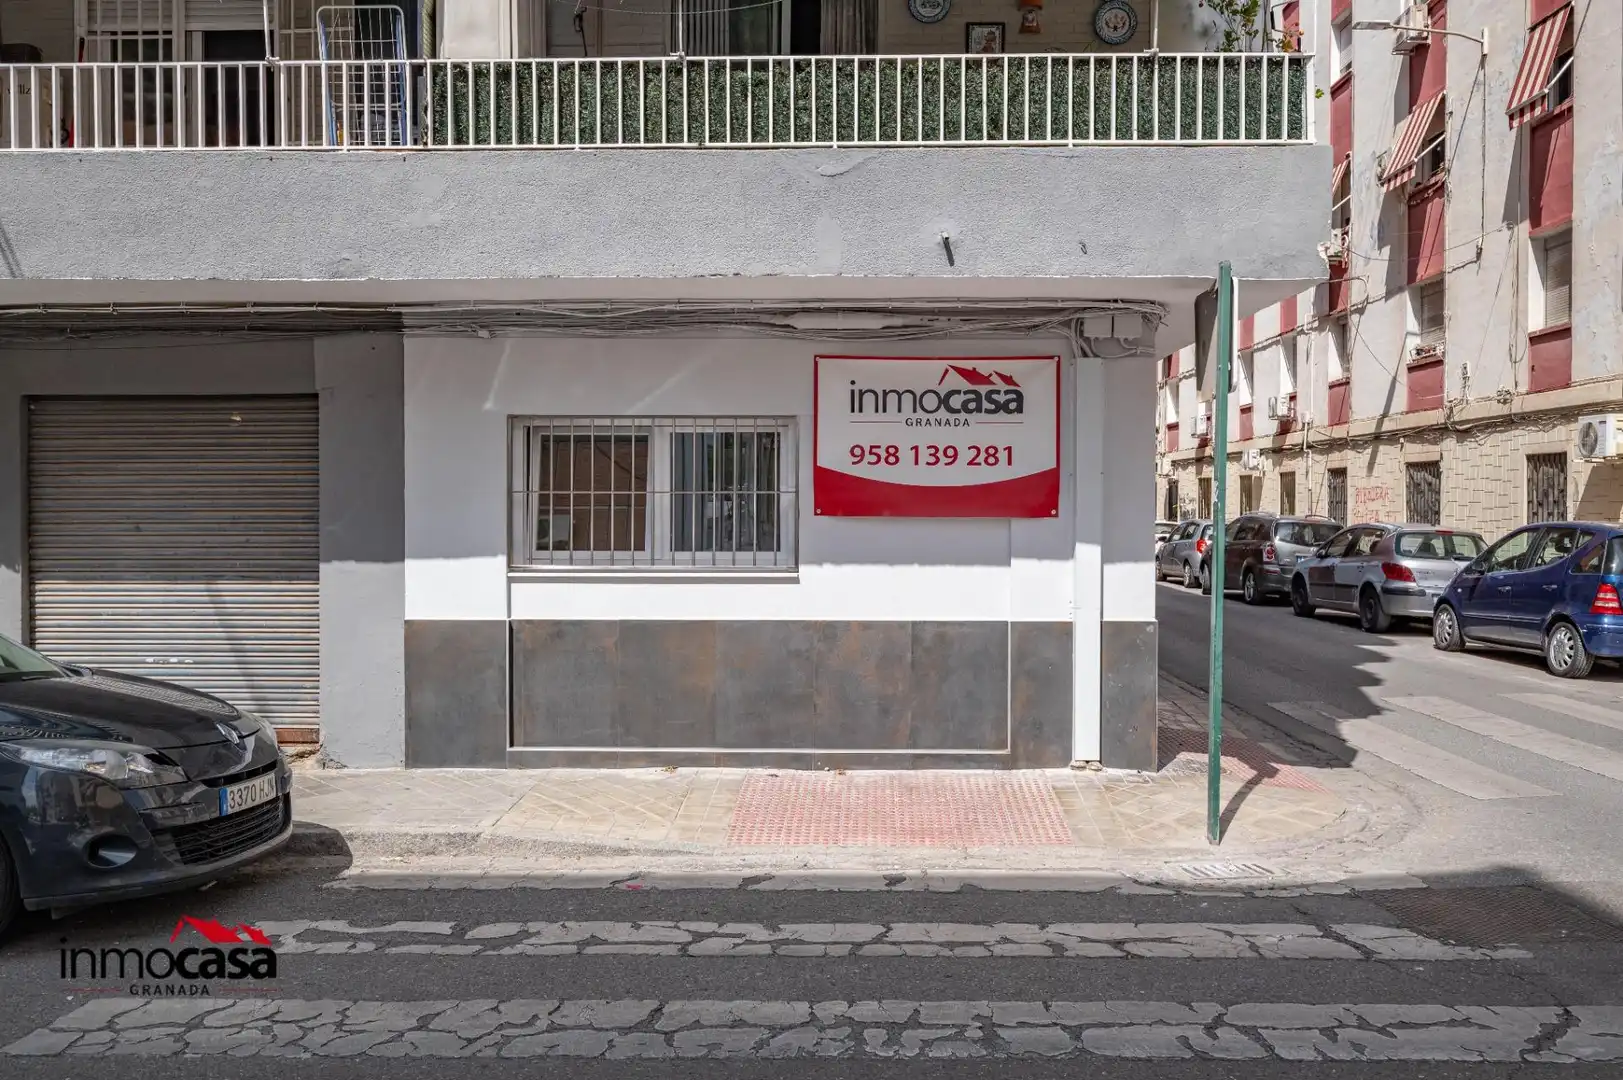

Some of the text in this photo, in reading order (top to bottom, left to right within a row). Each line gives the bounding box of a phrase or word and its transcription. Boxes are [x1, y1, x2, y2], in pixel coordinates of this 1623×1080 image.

[850, 380, 1024, 414] inmocasa
[905, 417, 970, 428] GRANADA
[849, 444, 1013, 466] 958 139 281
[229, 783, 257, 809] 3370
